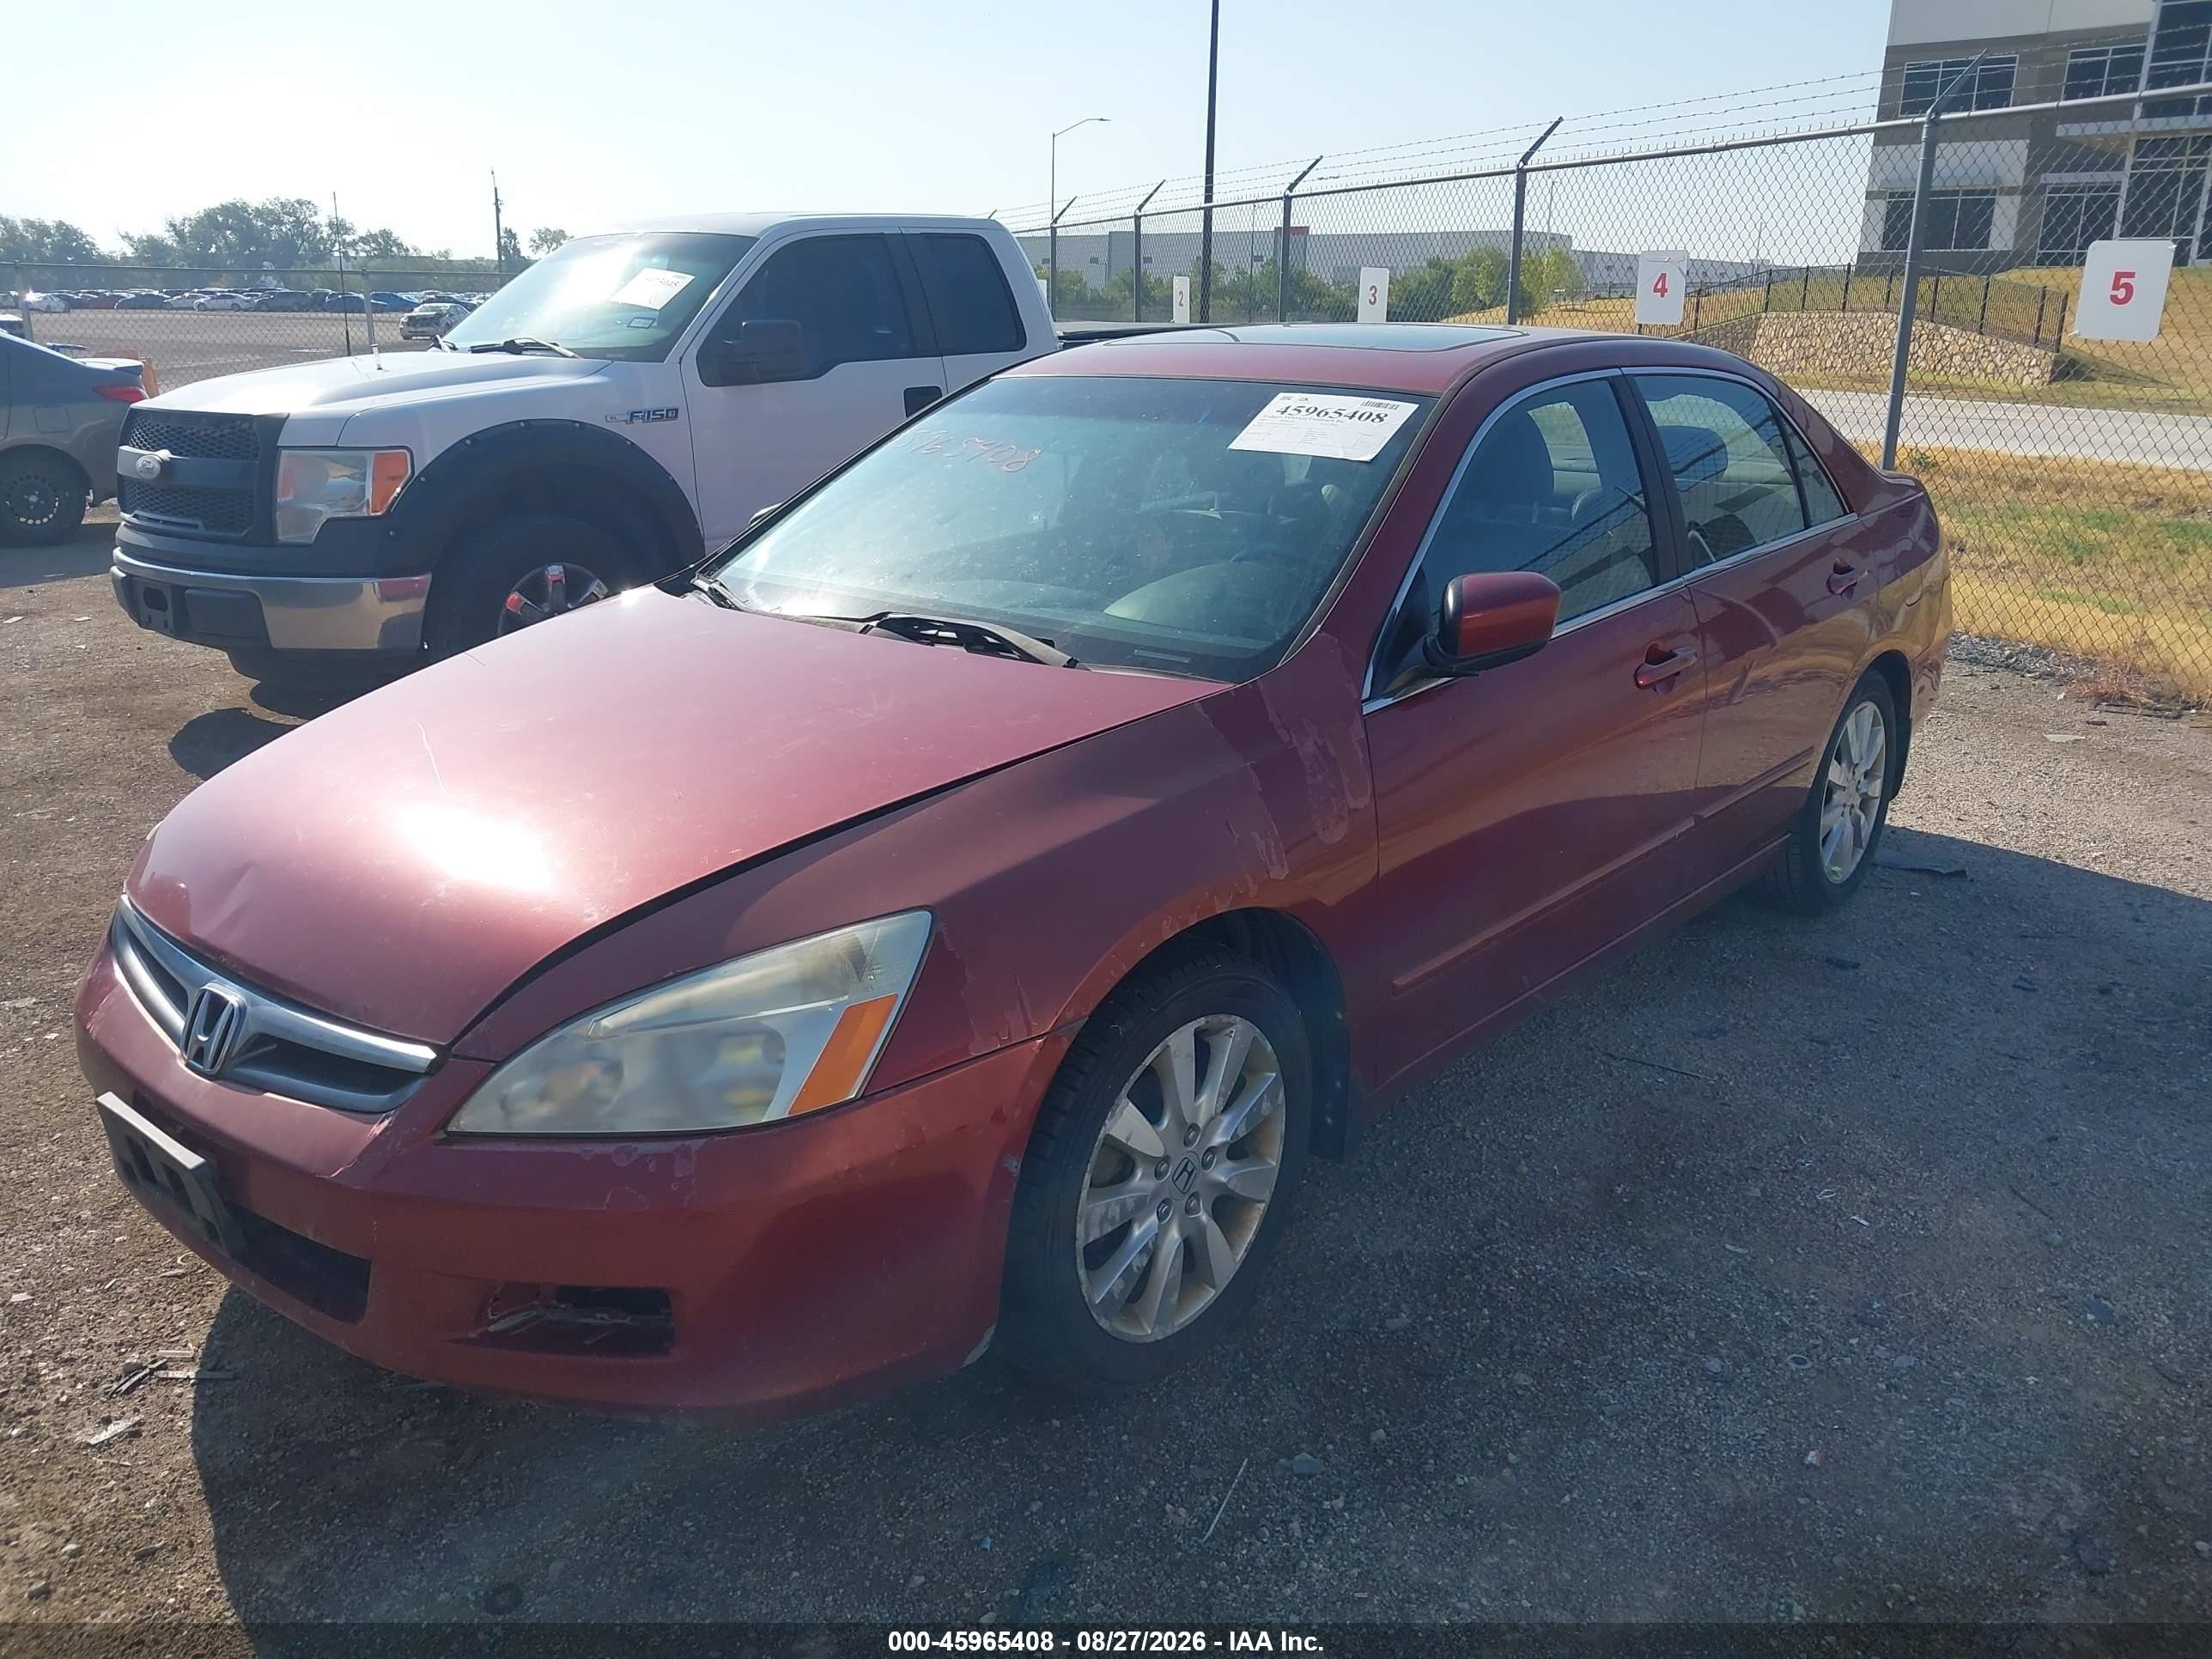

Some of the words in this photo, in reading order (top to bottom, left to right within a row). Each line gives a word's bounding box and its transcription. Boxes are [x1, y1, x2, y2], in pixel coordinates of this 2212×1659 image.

[1369, 285, 1377, 305] 3
[1654, 273, 1668, 297] 4
[2110, 271, 2136, 305] 5
[1179, 290, 1183, 307] 2
[1276, 404, 1389, 424] 45965408
